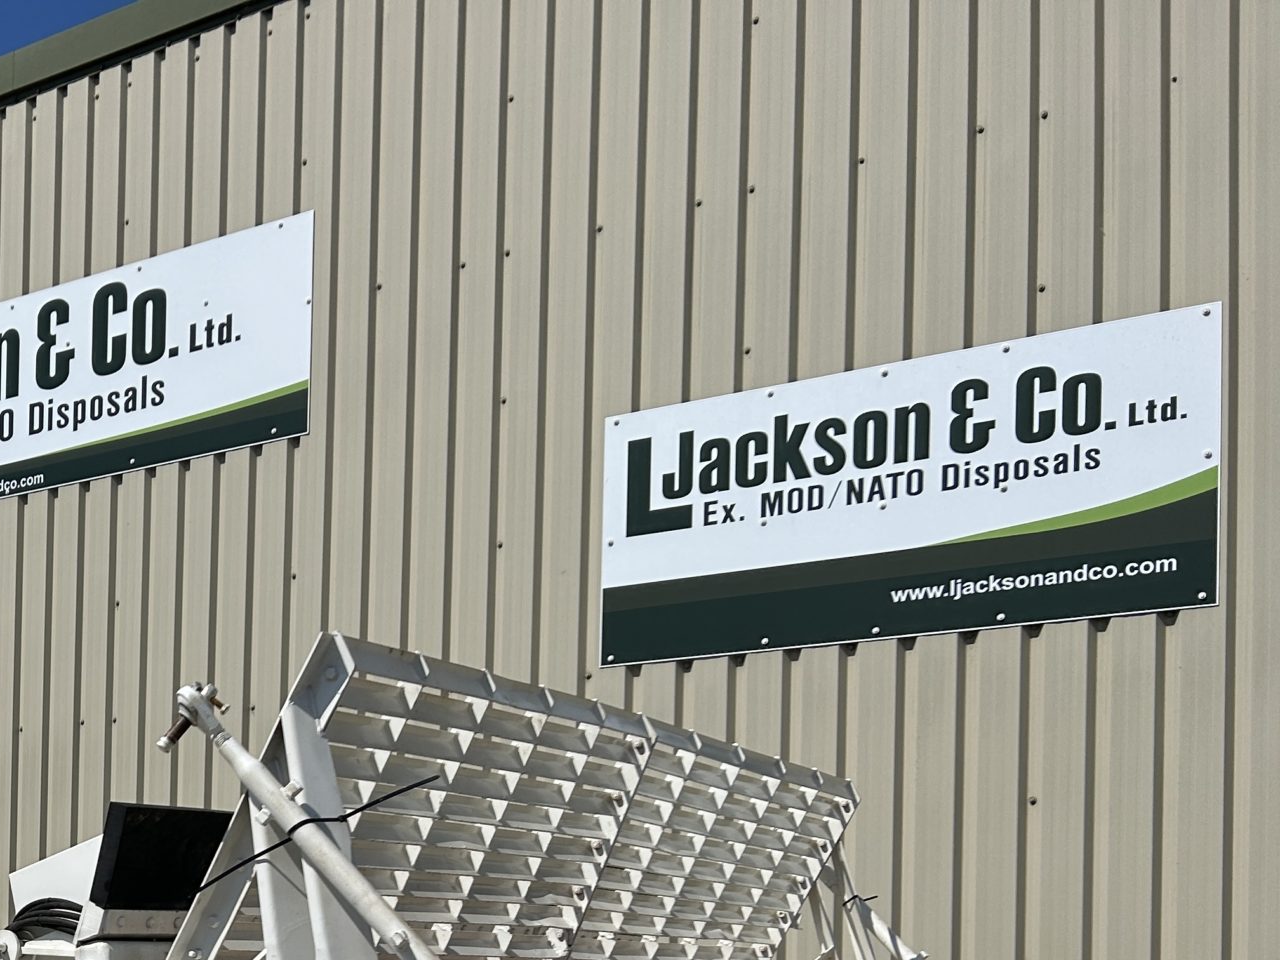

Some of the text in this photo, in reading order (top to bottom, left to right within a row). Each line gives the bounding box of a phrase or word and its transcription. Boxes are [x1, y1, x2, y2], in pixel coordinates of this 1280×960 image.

[36, 299, 74, 389] &
[92, 282, 179, 375] Co.
[190, 315, 241, 353] Ltd.
[29, 377, 165, 435] Disposals
[949, 379, 995, 453] &
[1016, 366, 1117, 443] Co.
[1128, 397, 1187, 426] Ltd.
[703, 445, 1102, 526] Ex. MOD/NATO Disposals
[891, 555, 1177, 603] www.ljacksonandco.com
